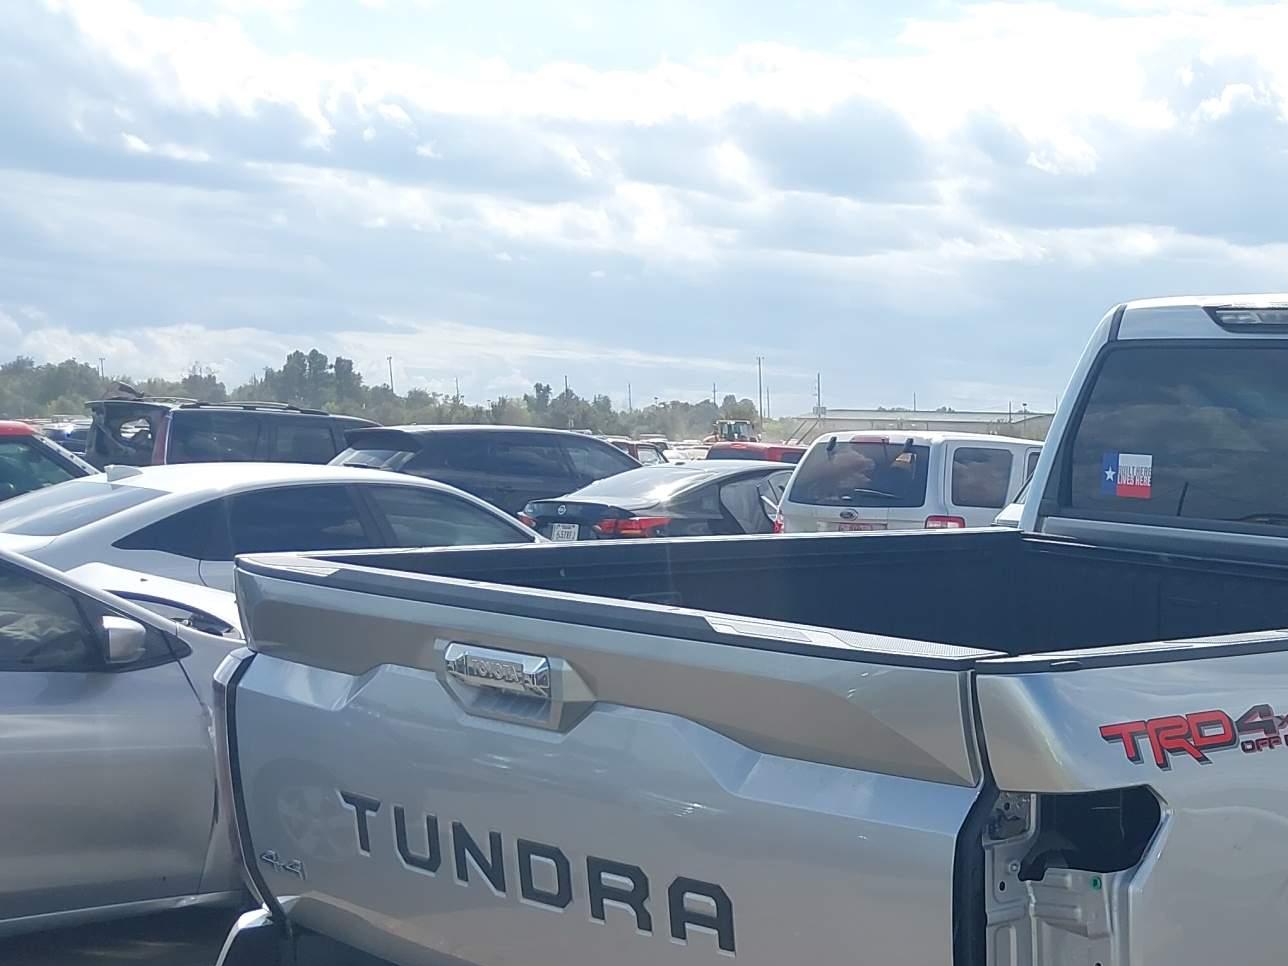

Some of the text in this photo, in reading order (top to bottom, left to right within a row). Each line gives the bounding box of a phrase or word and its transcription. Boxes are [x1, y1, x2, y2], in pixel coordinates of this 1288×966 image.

[1117, 474, 1151, 487] LIVES HERE
[472, 658, 520, 682] TOYOTA
[1099, 709, 1239, 771] TRD
[1240, 736, 1282, 754] OFF
[337, 790, 737, 957] TUNDRA
